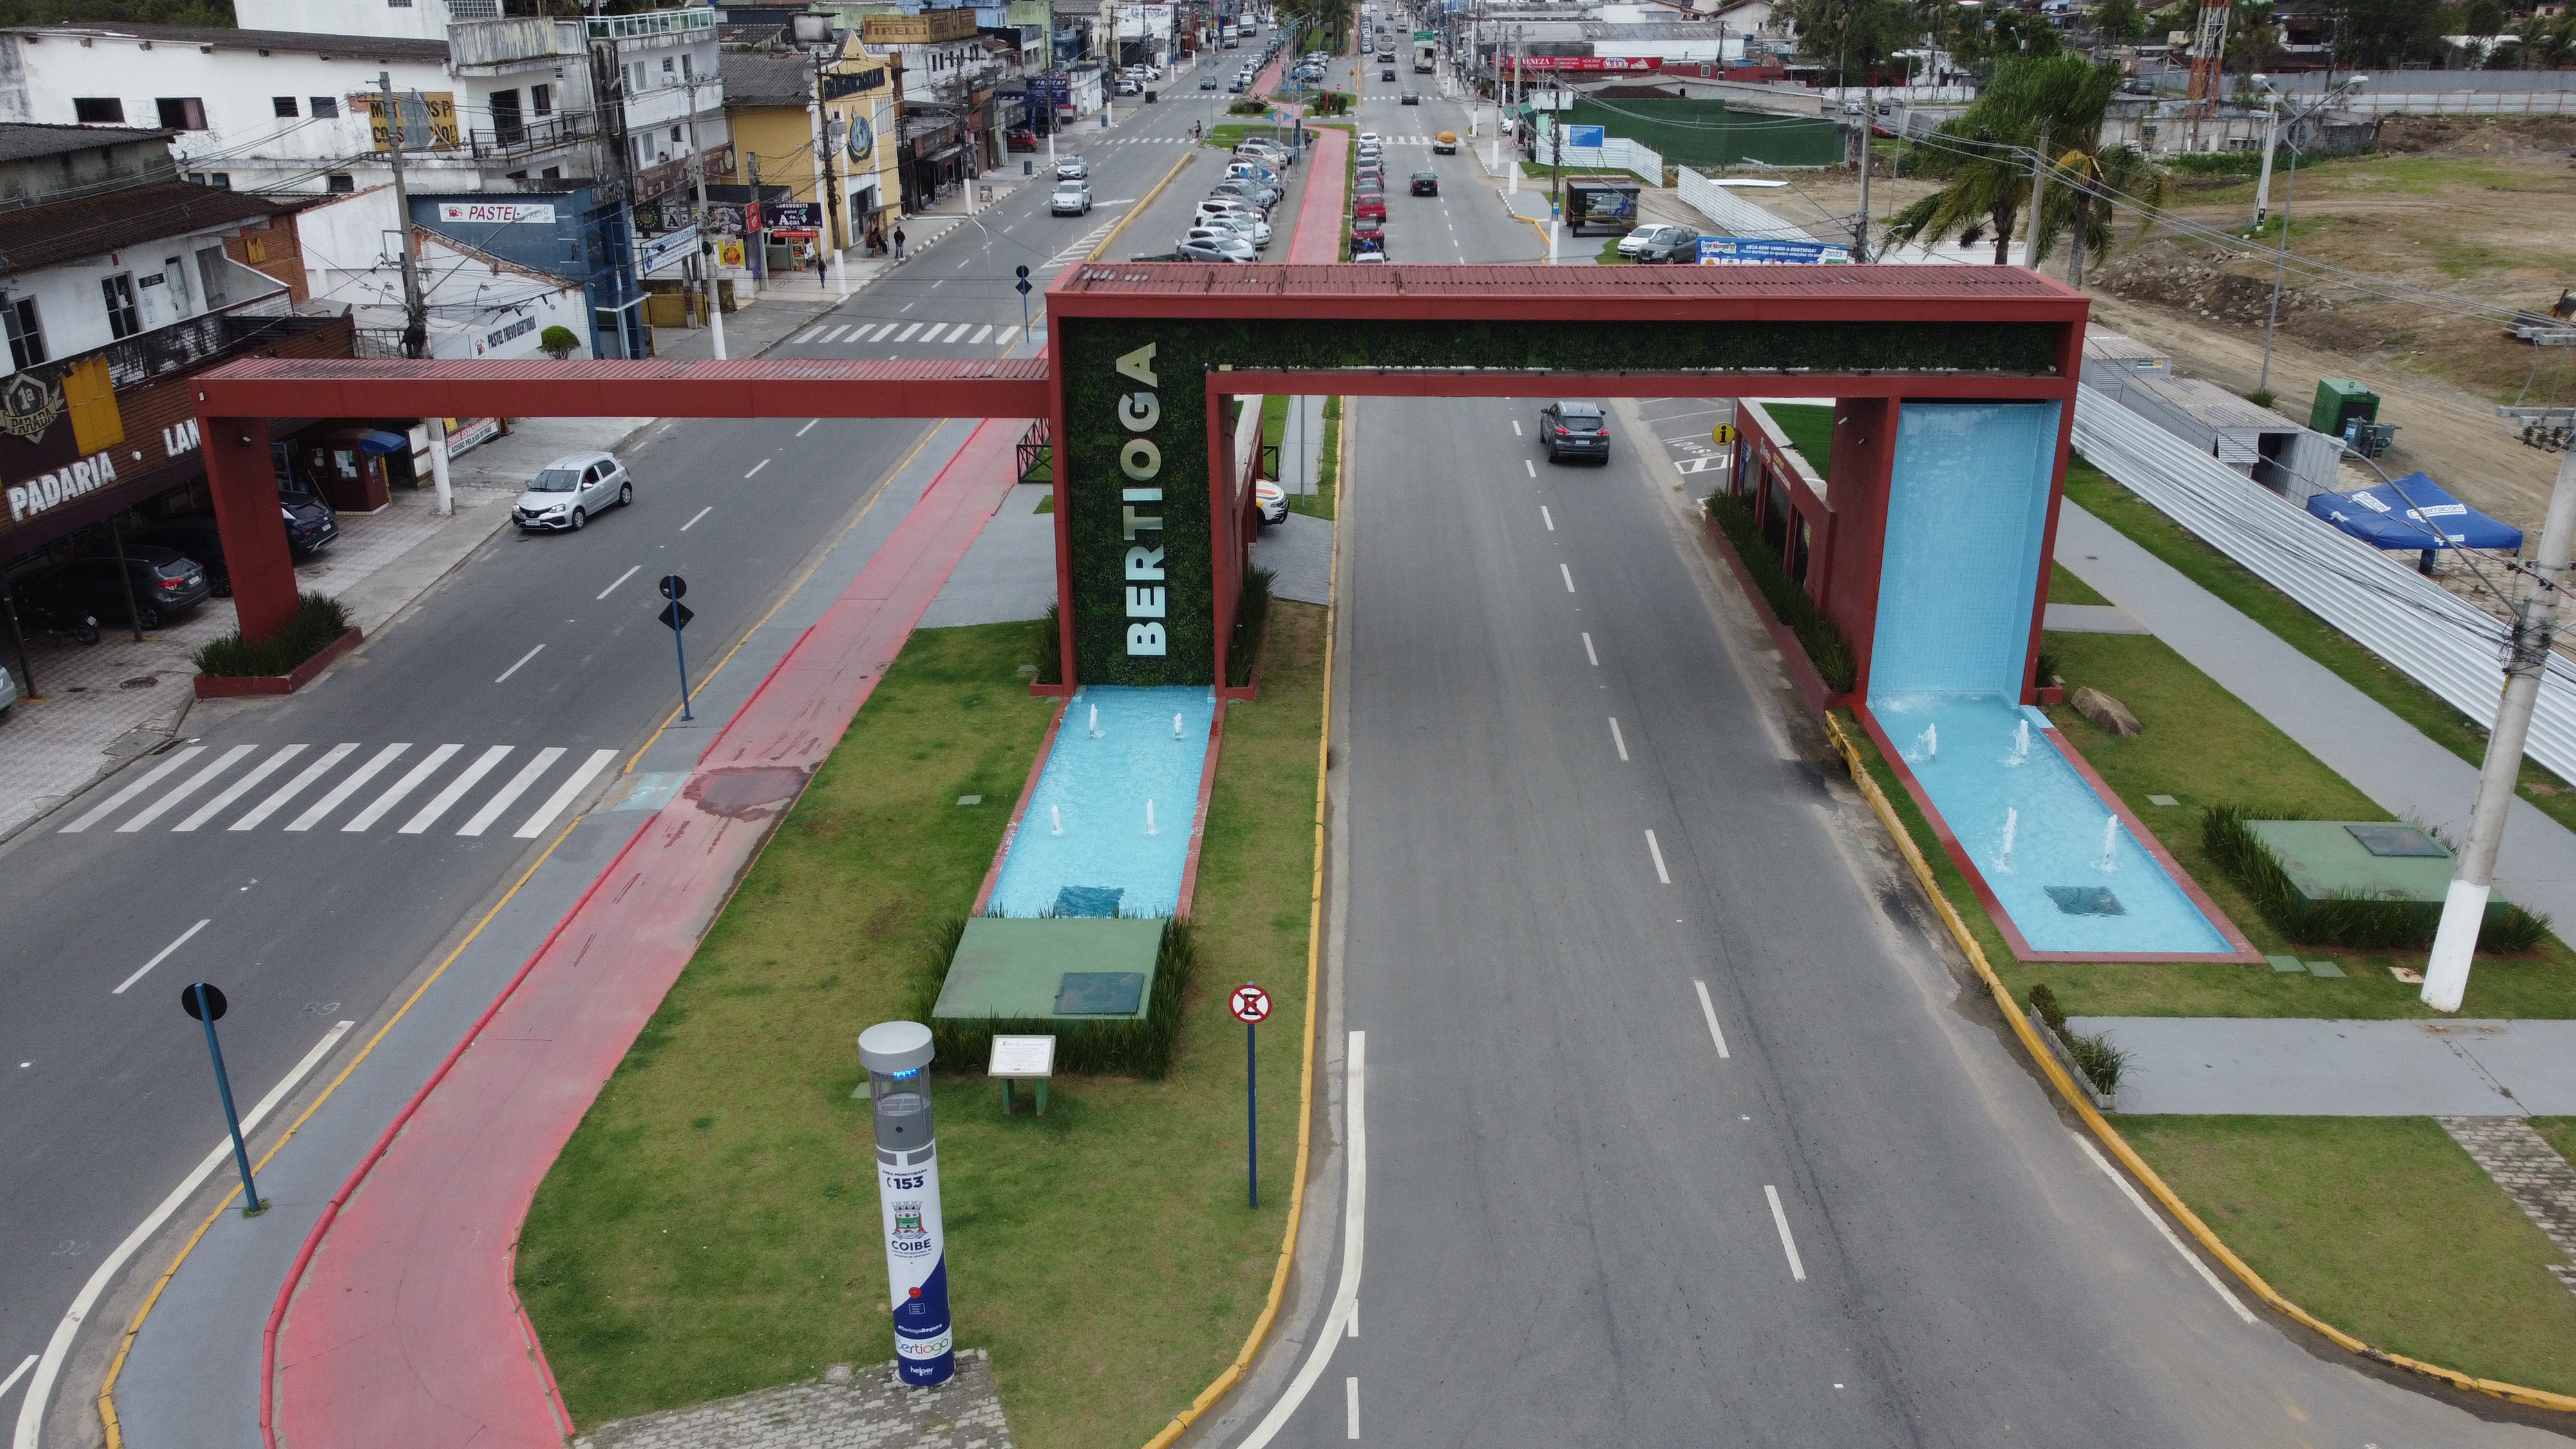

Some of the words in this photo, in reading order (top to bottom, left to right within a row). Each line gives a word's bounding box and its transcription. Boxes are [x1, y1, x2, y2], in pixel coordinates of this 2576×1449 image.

[488, 328, 504, 350] PASTEL
[502, 323, 517, 343] TREVO
[516, 315, 536, 337] BERTIOGA
[10, 407, 53, 433] PARADA
[6, 451, 118, 522] PADARIA
[1116, 341, 1166, 656] BERTIOGA
[893, 1175, 924, 1189] 153
[895, 1168, 927, 1177] MONITORADA
[891, 1238, 931, 1251] COIBE
[896, 1335, 949, 1356] Bertioga
[911, 1365, 934, 1376] helper
